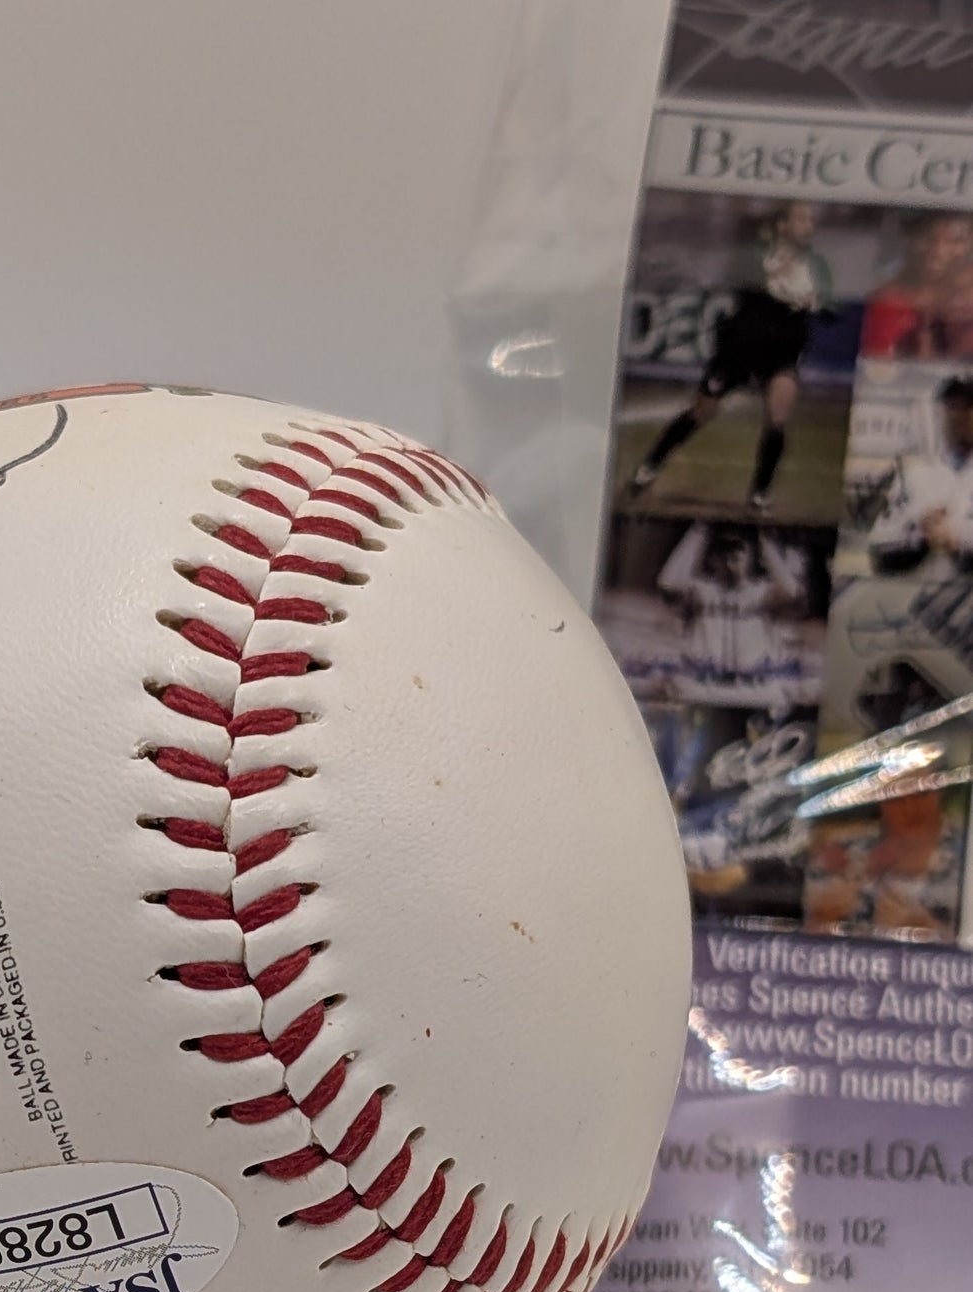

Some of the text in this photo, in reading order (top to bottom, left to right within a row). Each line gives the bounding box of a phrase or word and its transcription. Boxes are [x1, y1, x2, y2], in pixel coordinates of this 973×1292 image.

[683, 122, 852, 188] Basic
[707, 933, 973, 991] Verification inqu
[2, 955, 40, 1057] PACKAGED
[748, 974, 872, 1020] Spence
[877, 984, 973, 1029] Authe
[1, 1027, 27, 1077] MADE
[29, 1058, 53, 1095] AND
[17, 1077, 43, 1122] BALL
[839, 1063, 967, 1108] number
[43, 1098, 79, 1164] RINTED
[631, 1217, 680, 1242] van
[840, 1216, 886, 1247] 102
[607, 1256, 707, 1287] sippany,
